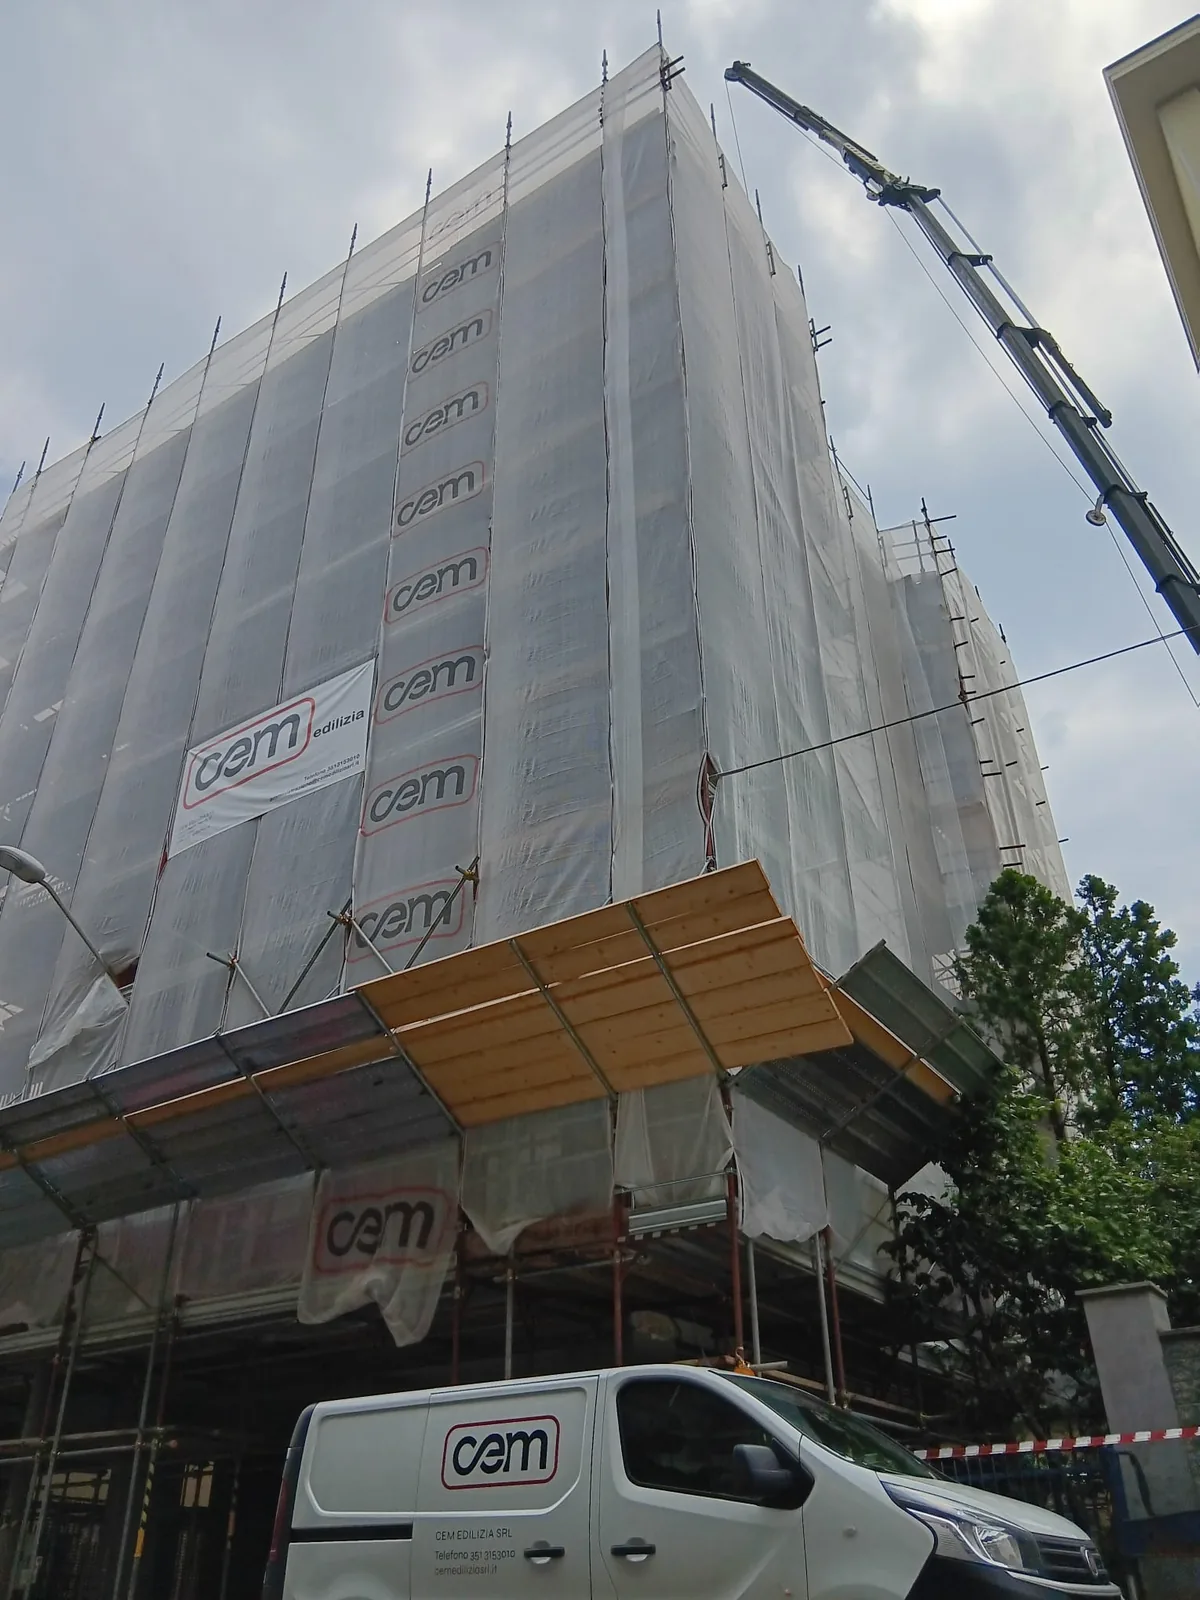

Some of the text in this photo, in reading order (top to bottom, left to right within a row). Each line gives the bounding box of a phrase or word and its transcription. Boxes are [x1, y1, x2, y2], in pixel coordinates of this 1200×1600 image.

[422, 250, 492, 303] cem
[411, 318, 483, 373] cem
[405, 391, 478, 446] cem
[397, 471, 474, 526] cem
[393, 557, 477, 612] cem
[384, 655, 476, 711] cem
[313, 709, 365, 738] edilizia
[195, 713, 300, 791] cem
[370, 765, 465, 822] cem
[355, 890, 451, 949] cem
[327, 1201, 434, 1256] cem
[452, 1429, 548, 1476] cem
[435, 1528, 513, 1541] CEM EDILIZIA SRL
[435, 1550, 516, 1561] Telefono 351 3153010
